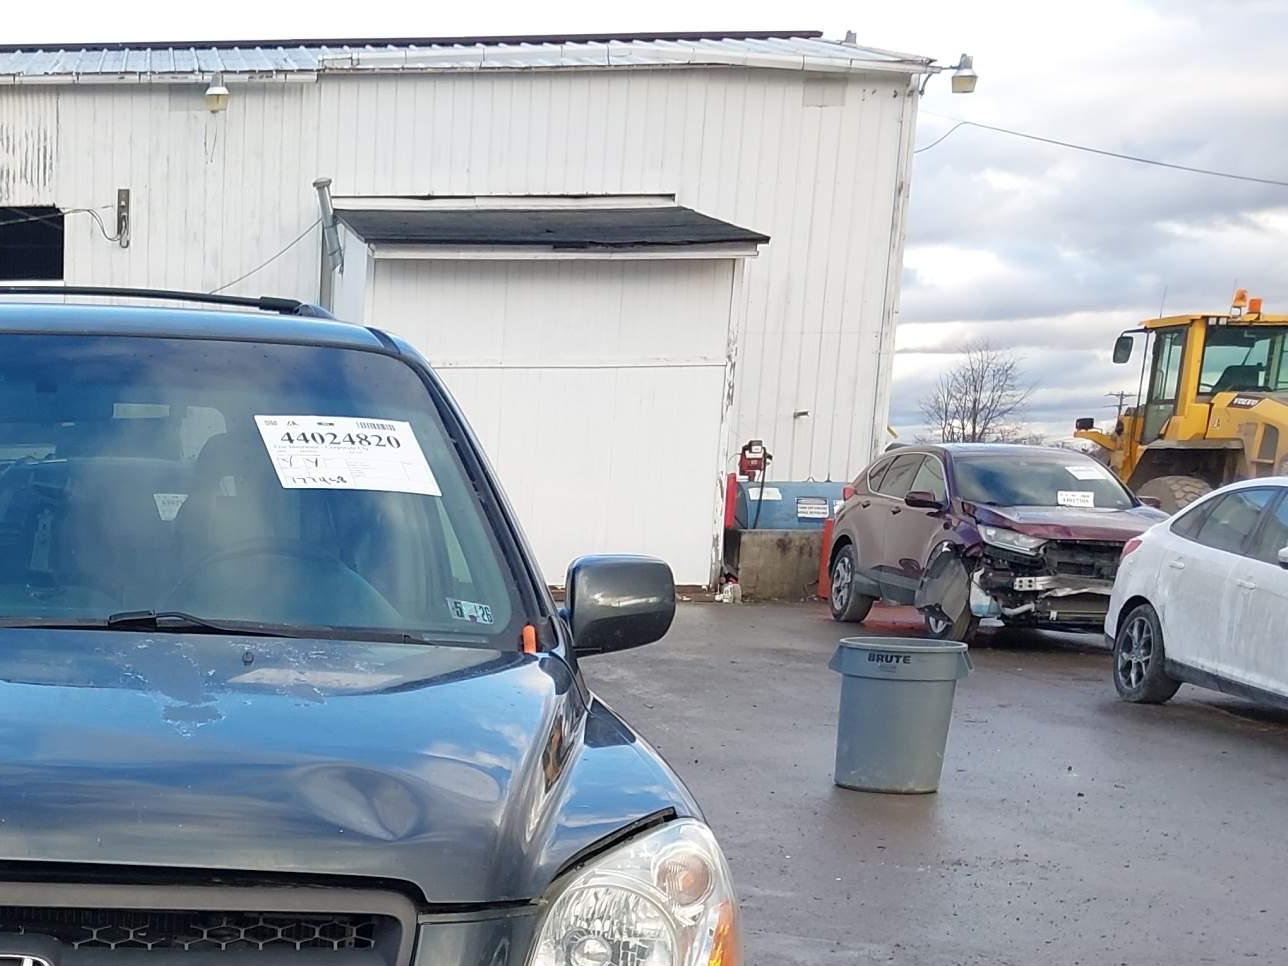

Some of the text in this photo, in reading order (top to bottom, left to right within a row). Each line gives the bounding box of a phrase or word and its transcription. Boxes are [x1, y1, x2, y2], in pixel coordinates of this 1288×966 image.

[280, 431, 402, 450] 44024820
[454, 601, 465, 618] 5
[867, 652, 912, 665] BRUTE
